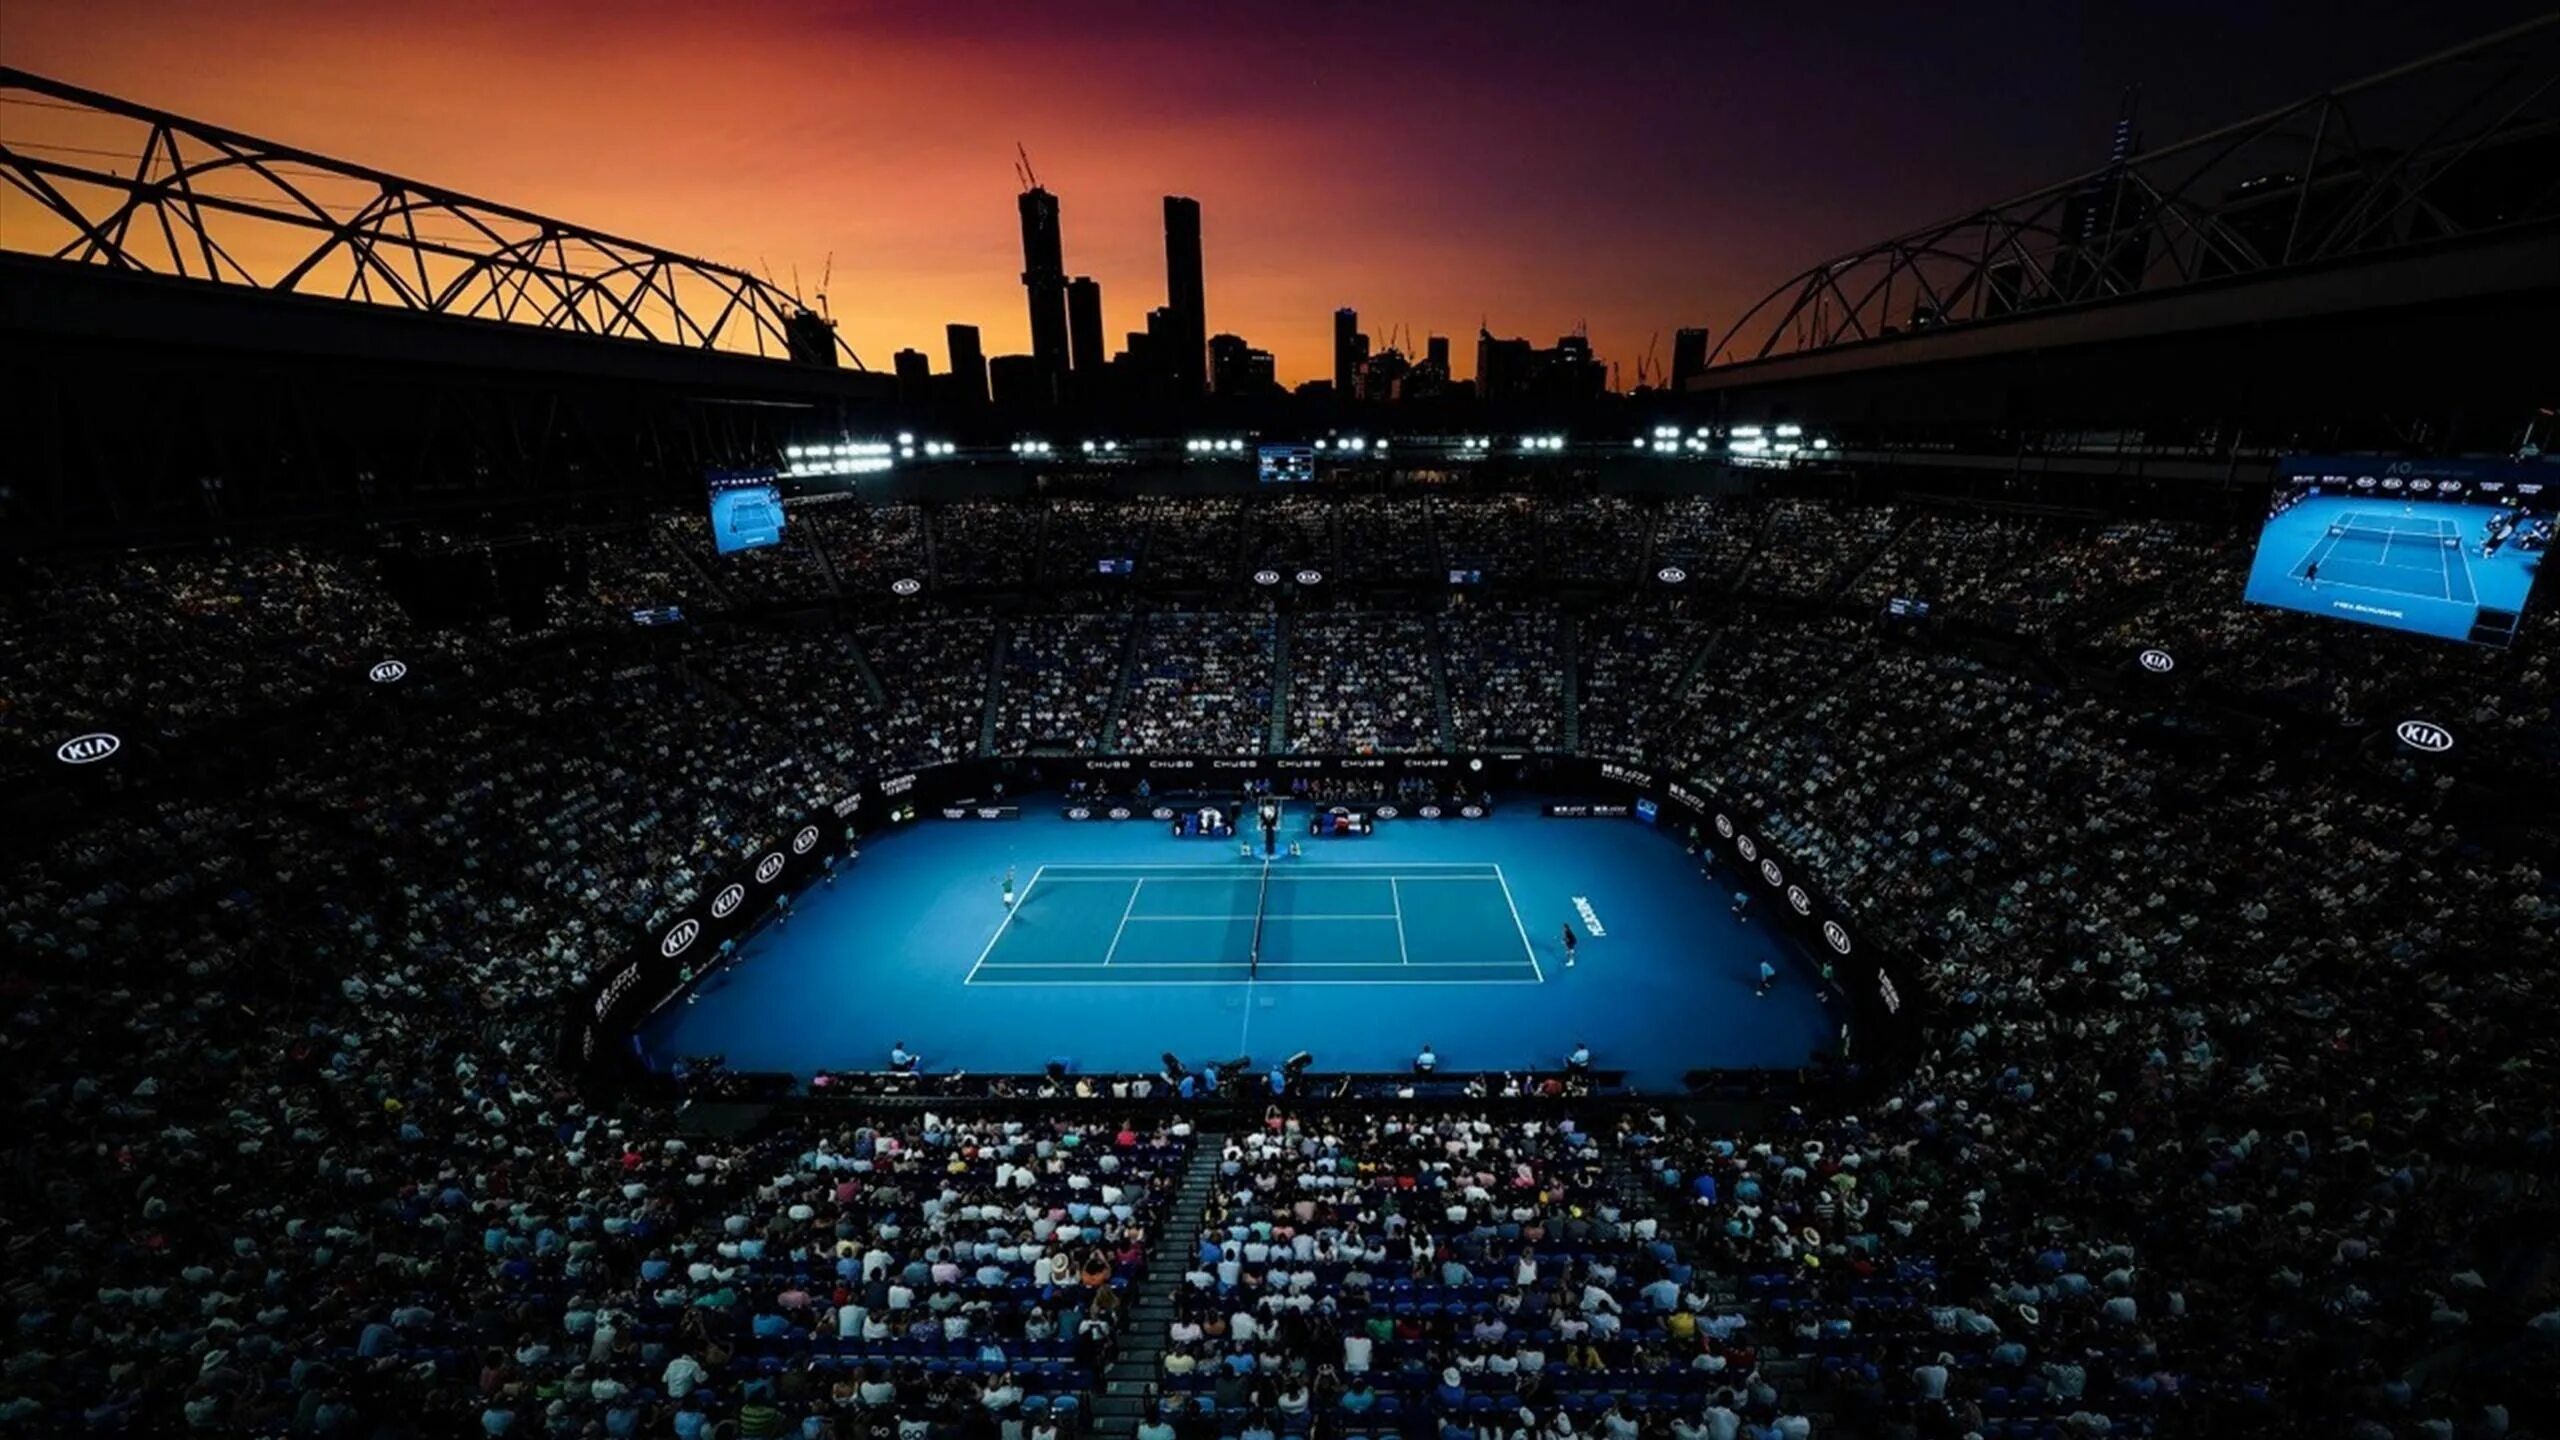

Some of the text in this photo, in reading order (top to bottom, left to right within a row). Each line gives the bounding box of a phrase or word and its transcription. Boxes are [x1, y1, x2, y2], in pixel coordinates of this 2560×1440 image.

[374, 663, 403, 681] KIA
[2144, 652, 2170, 672] KIA
[65, 737, 113, 760] KIA
[2403, 723, 2446, 750] KIA
[759, 854, 782, 881] KIA
[715, 886, 742, 915] KIA
[665, 922, 696, 955] KIA
[1827, 924, 1847, 952] KIA
